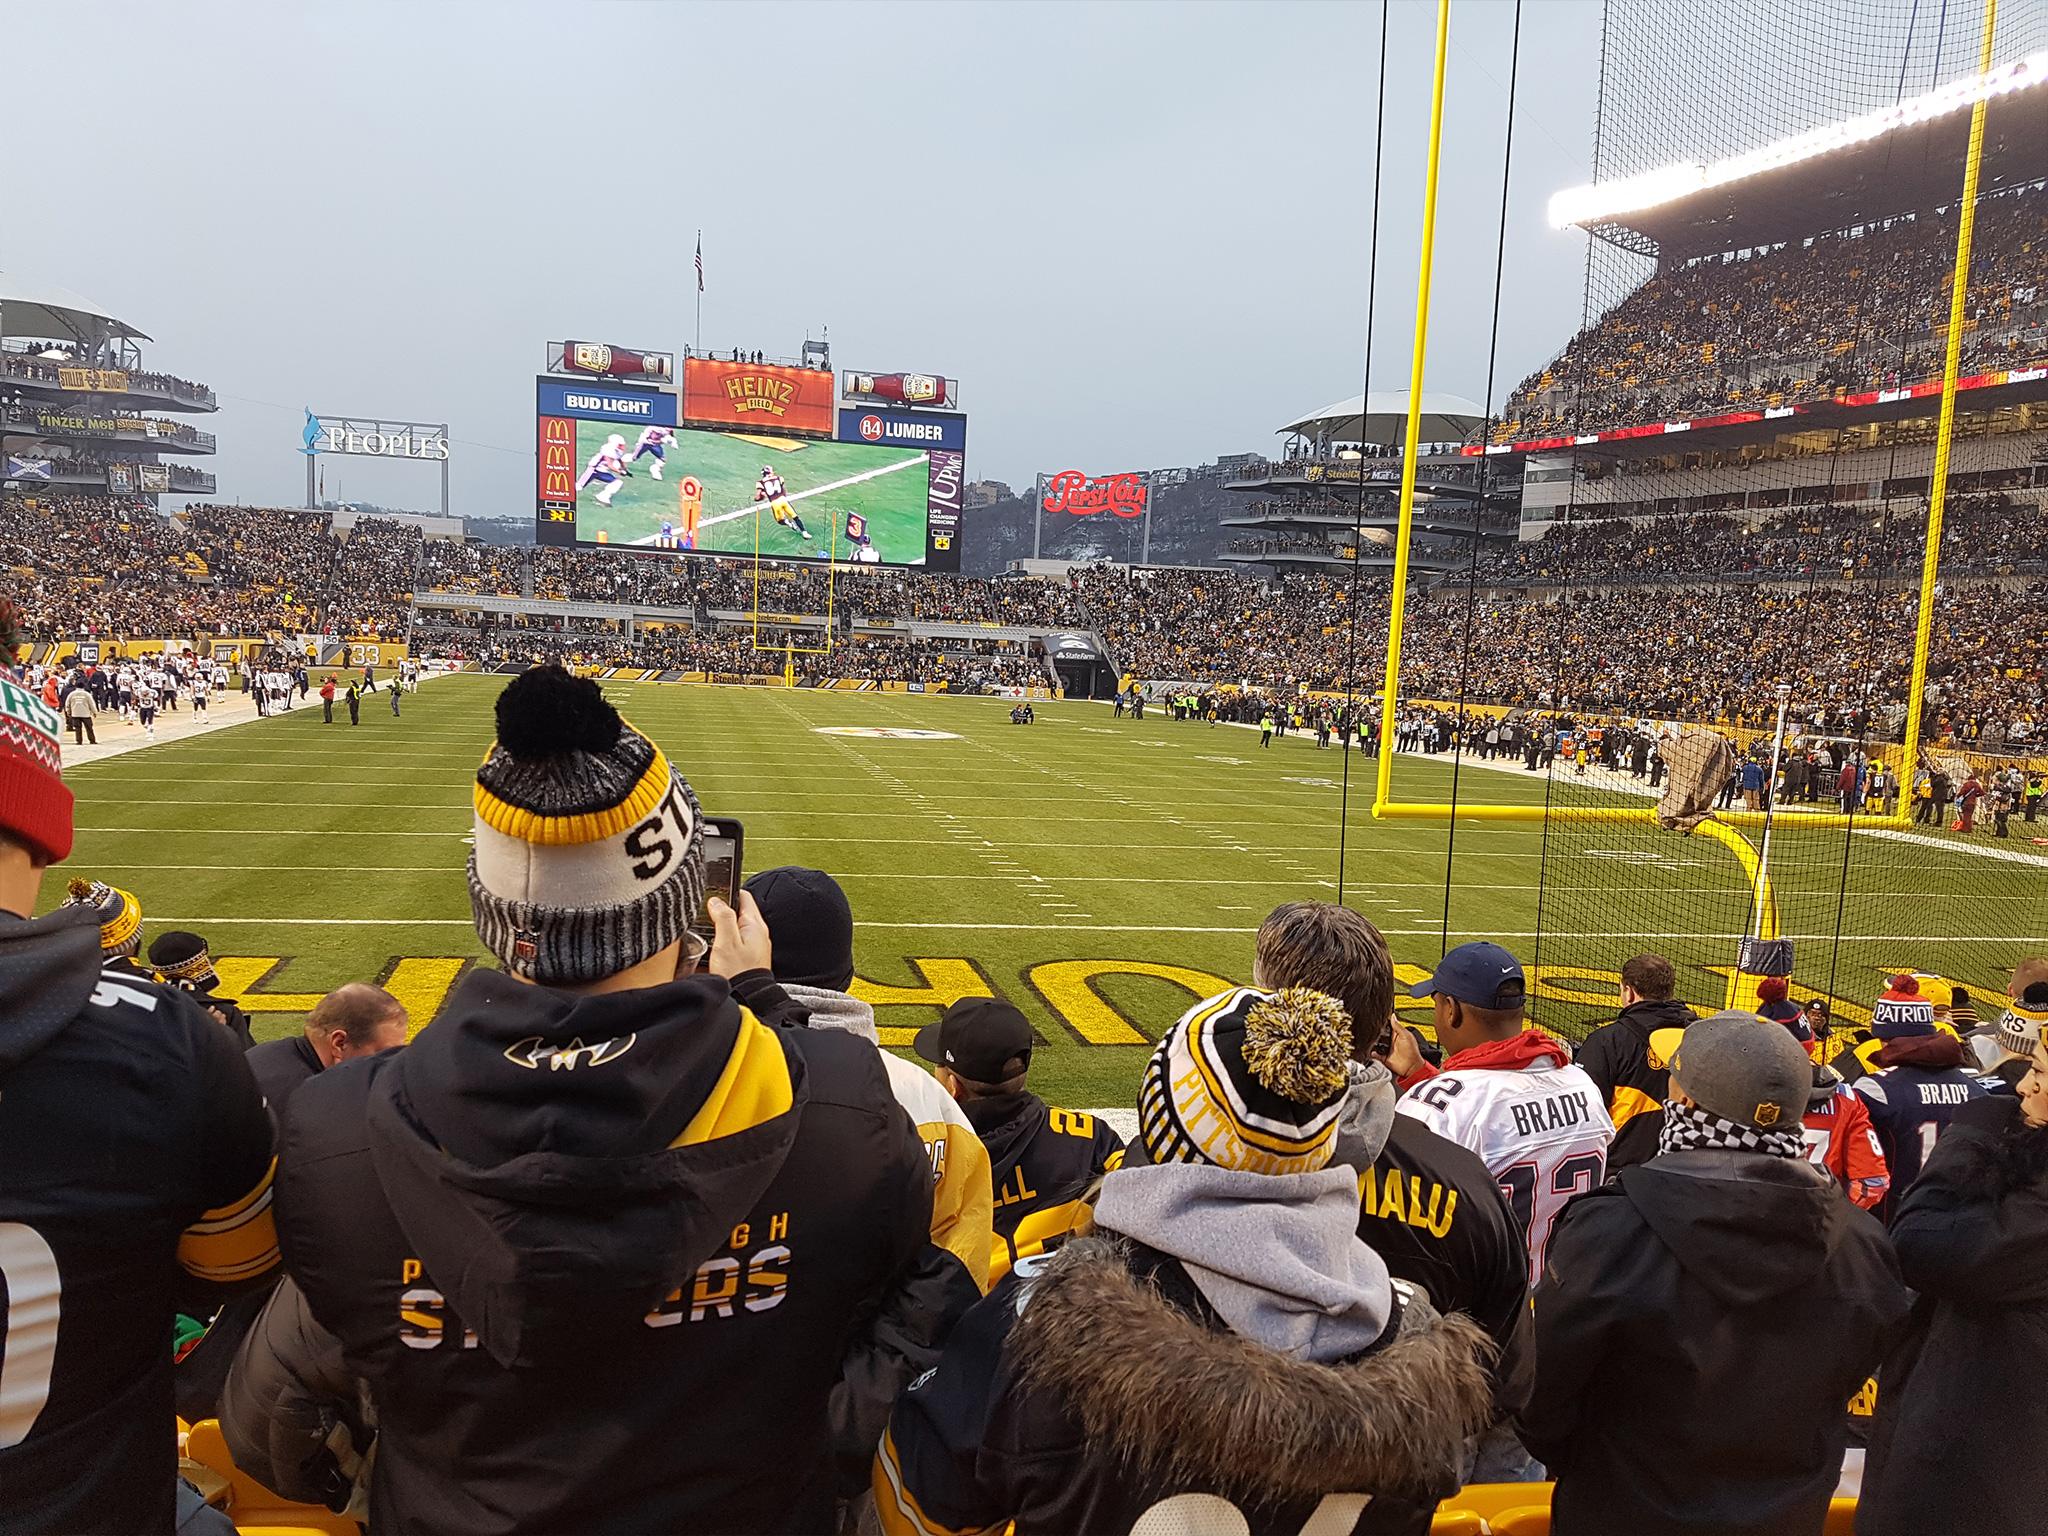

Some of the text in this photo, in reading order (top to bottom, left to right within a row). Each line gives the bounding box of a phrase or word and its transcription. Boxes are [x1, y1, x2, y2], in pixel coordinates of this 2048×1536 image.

[725, 376, 794, 404] HEINZ
[566, 394, 650, 415] BUD LIGHT
[750, 399, 771, 409] FIELD
[37, 414, 115, 431] YINZER MOB
[862, 420, 943, 441] 84 LUMBER
[328, 427, 450, 460] PEOPLES
[929, 455, 962, 500] UPMC
[352, 645, 381, 665] 33
[1874, 776, 1884, 788] 81
[1409, 1077, 1466, 1114] 12
[1917, 1084, 1969, 1105] BRADY
[1510, 1091, 1590, 1137] BRADY
